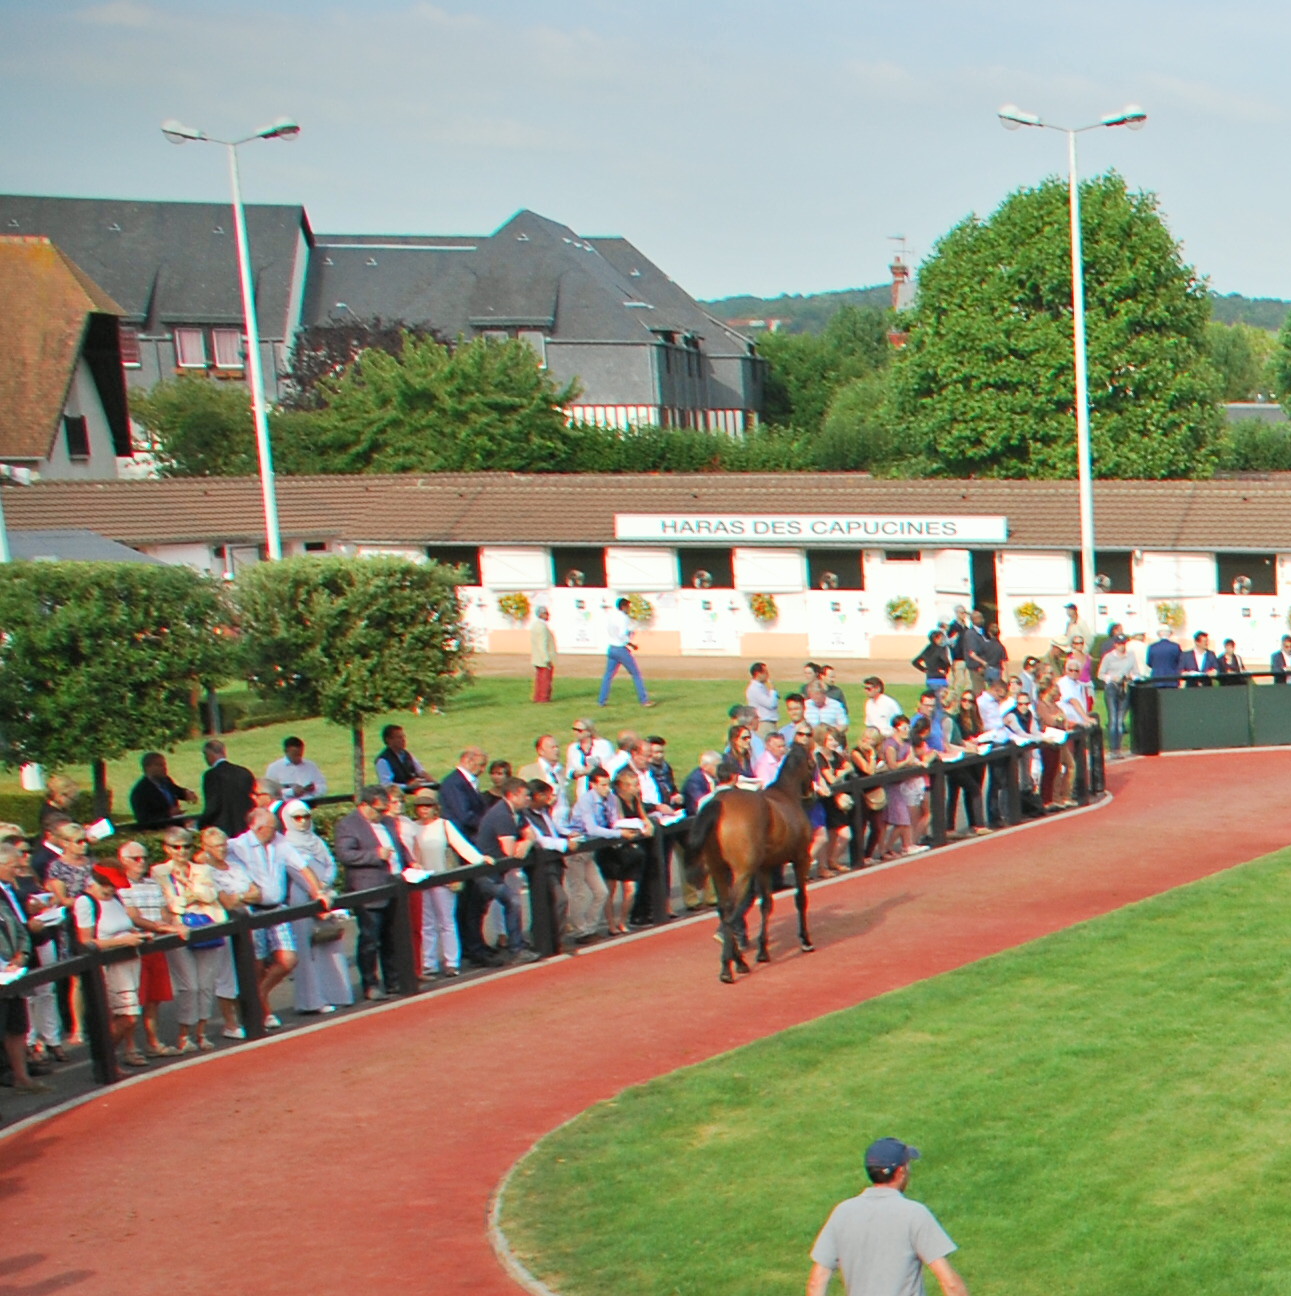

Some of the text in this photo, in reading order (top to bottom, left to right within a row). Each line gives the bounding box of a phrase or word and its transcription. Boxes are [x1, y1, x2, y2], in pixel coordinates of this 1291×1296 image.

[660, 520, 957, 536] HARAS DES CAPUCINES
